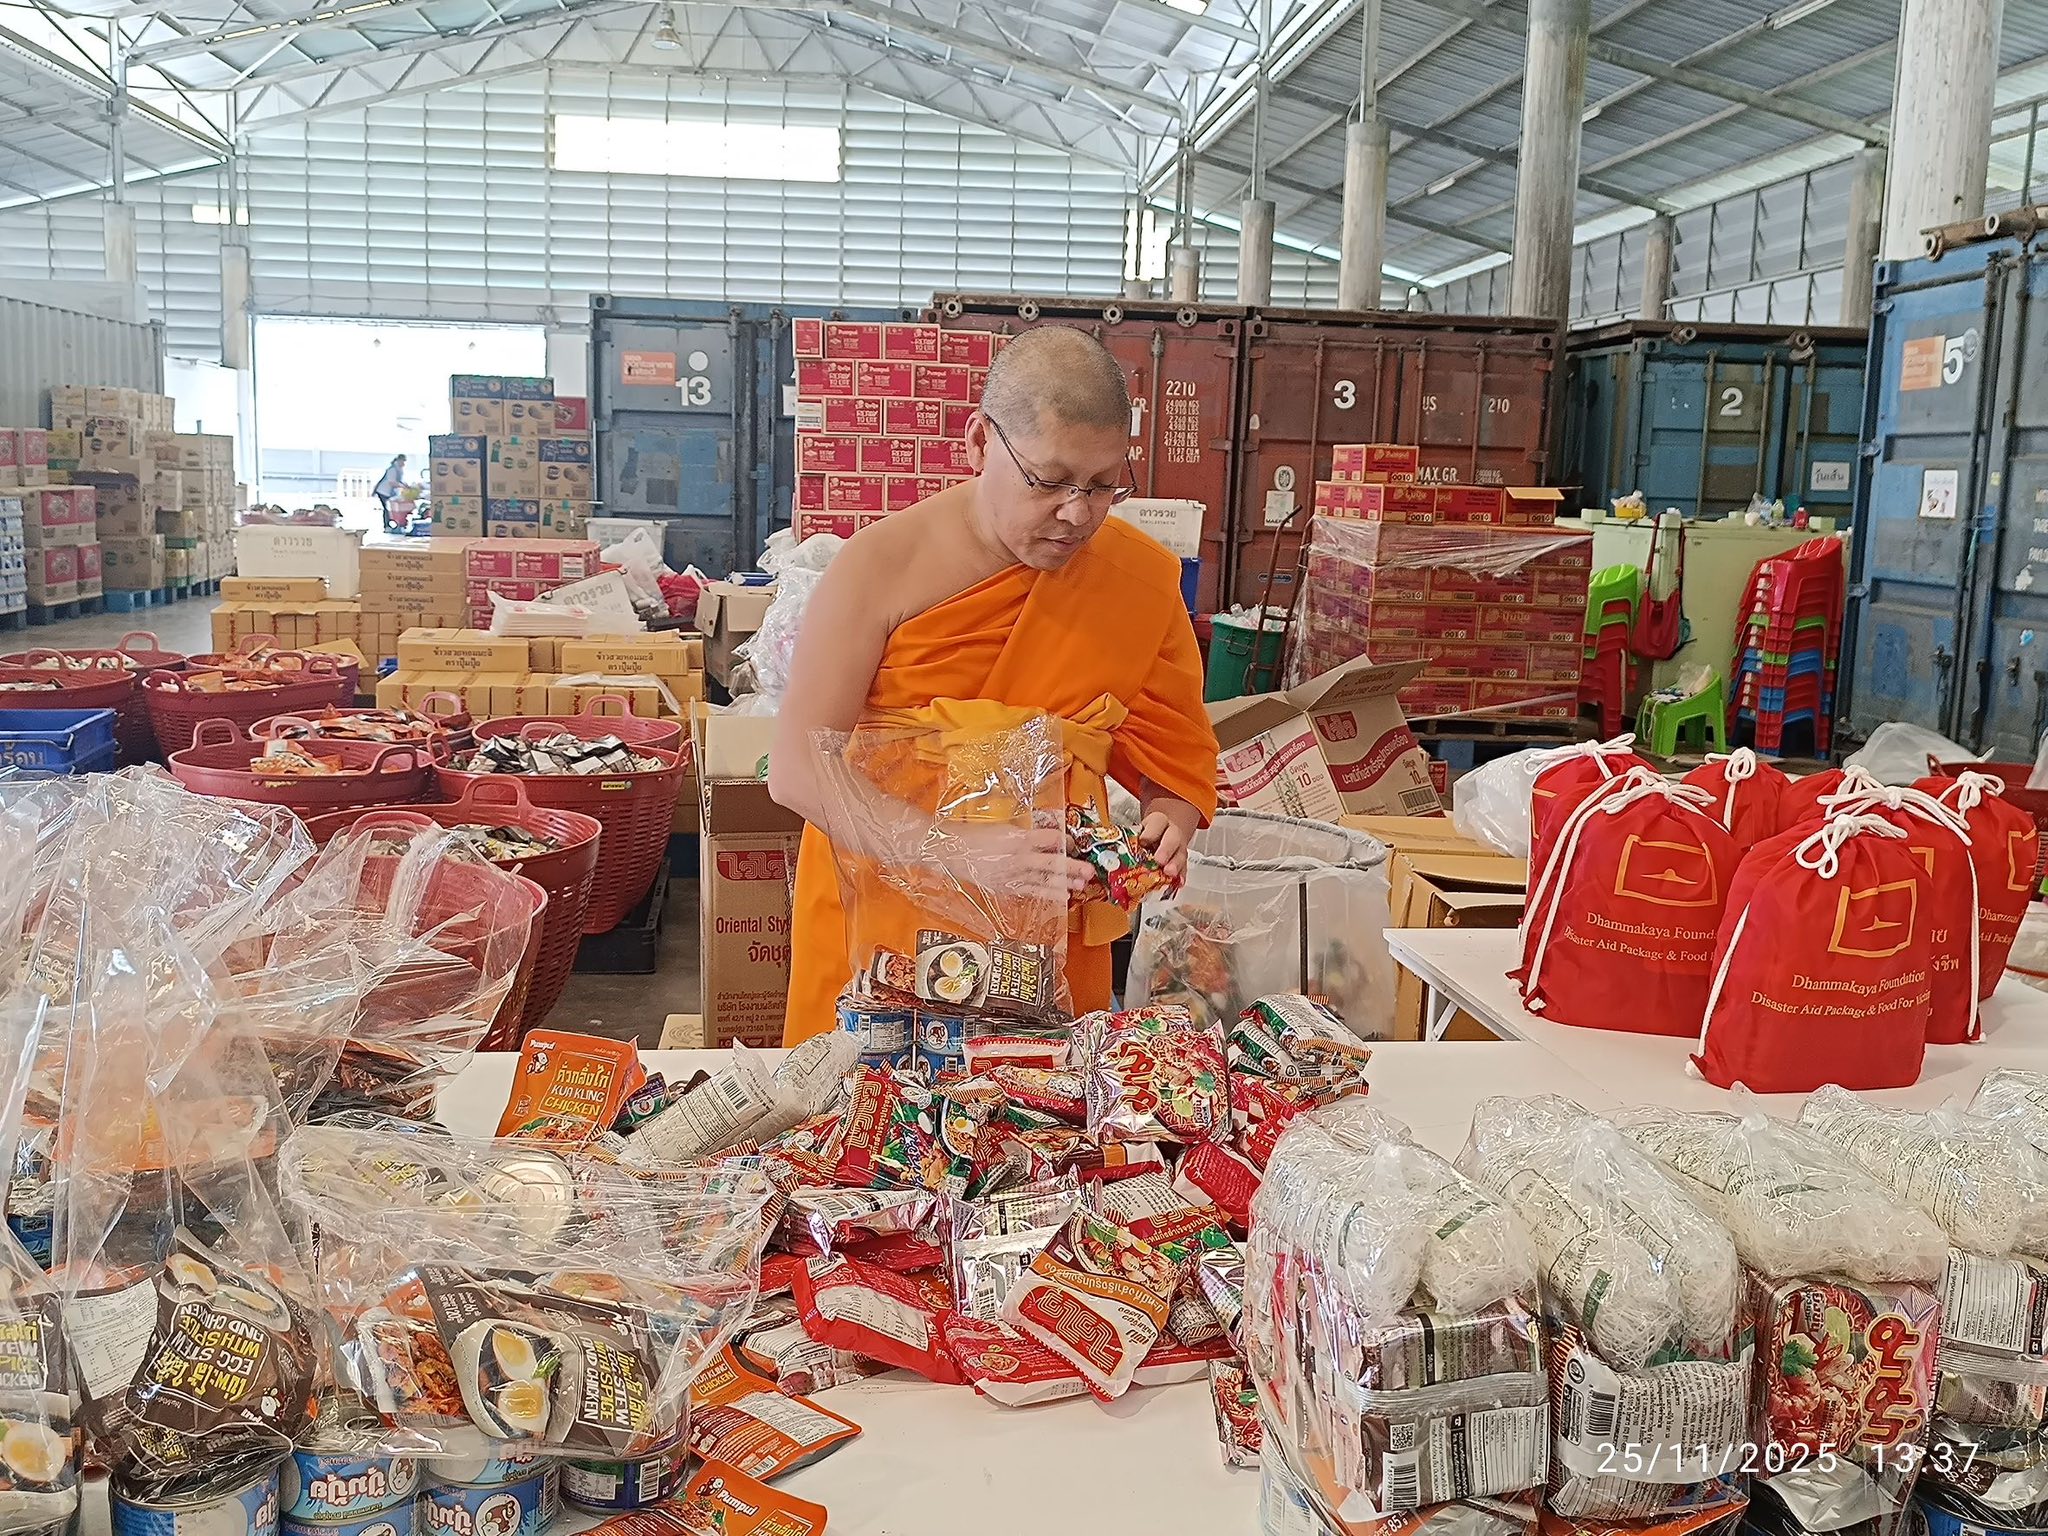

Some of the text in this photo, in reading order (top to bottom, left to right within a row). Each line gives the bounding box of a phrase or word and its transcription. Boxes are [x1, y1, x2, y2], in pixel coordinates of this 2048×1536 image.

[1943, 335, 1965, 385] 5
[675, 376, 711, 406] 13
[1166, 380, 1196, 396] 2210
[1333, 379, 1356, 410] 3
[1719, 387, 1744, 417] 2
[1422, 396, 1437, 411] US
[1391, 473, 1411, 481] 0010
[1295, 772, 1312, 788] 10
[1409, 770, 1421, 785] 10
[716, 917, 762, 934] Oriental
[1586, 911, 1670, 939] Dhammakaya
[1563, 925, 1707, 962] Disaster Aid Package & Food
[1000, 968, 1011, 996] SPICE
[1010, 971, 1020, 998] STEW
[1792, 970, 1926, 997] Dhammakaya Foundation
[1751, 991, 1914, 1019] Disaster Aid Package & Food For
[556, 1061, 611, 1088] คั่วกลิ้งไก่
[544, 1096, 600, 1116] CHICKEN
[180, 1302, 227, 1331] CHICKEN
[178, 1314, 261, 1358] WITH SPICE
[170, 1331, 254, 1375] EGG STEW
[584, 1367, 599, 1420] CHICKEN
[593, 1341, 614, 1423] WITH SPICE
[605, 1345, 628, 1426] EGG STEW
[699, 1371, 734, 1394] CHICKEN
[309, 1466, 386, 1507] ปุ้มปุ้ย
[426, 1495, 472, 1536] ปุ้มปุ้
[717, 1489, 759, 1517] Pumpui
[1387, 1514, 1402, 1532] 85
